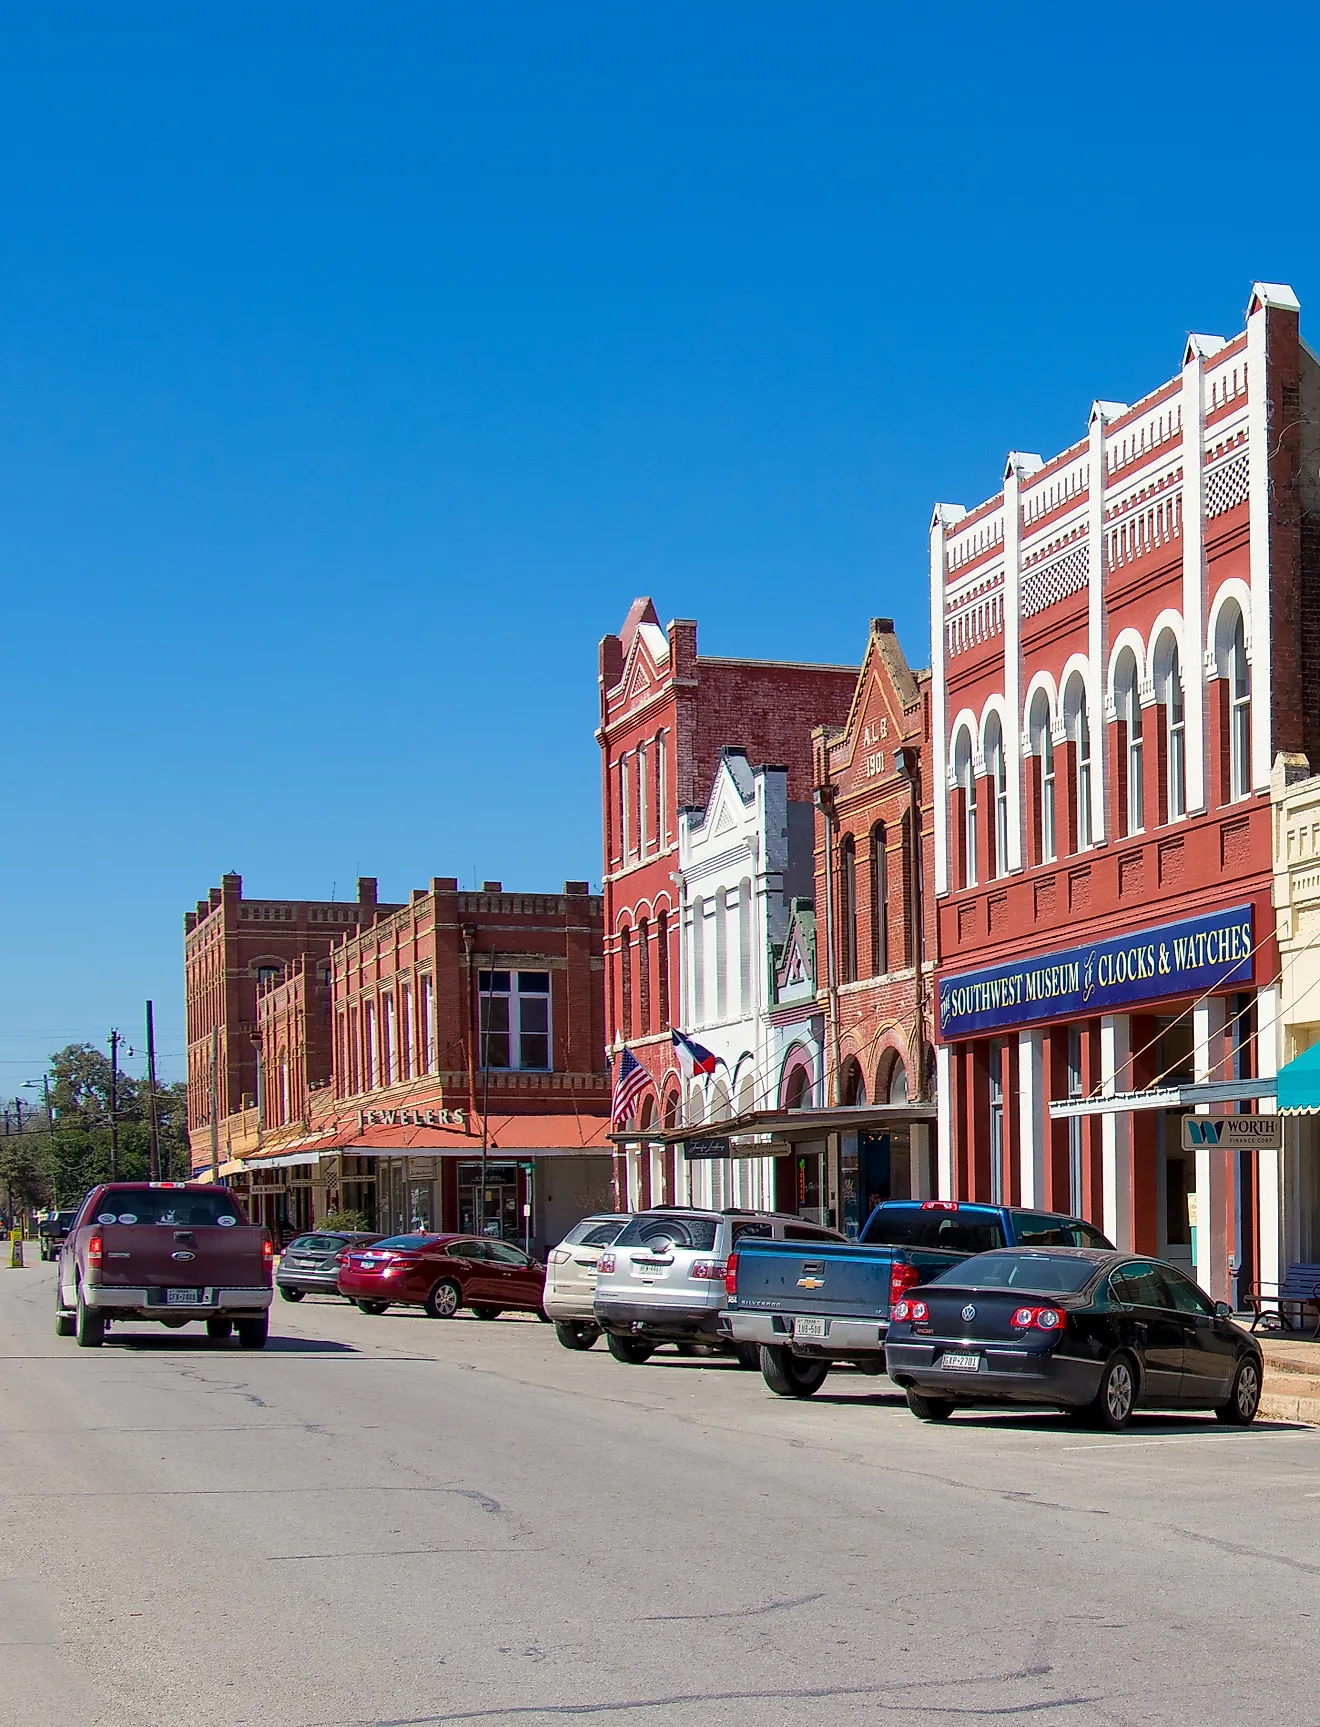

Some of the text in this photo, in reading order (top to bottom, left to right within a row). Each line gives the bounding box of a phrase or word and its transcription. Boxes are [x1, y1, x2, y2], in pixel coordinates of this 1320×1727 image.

[867, 751, 885, 778] 1901
[951, 973, 1023, 1017] SOUTHWEST
[1025, 961, 1079, 1002] MUSEUM
[1098, 944, 1154, 987] CLOCKS
[1158, 942, 1171, 975] &
[1173, 923, 1250, 972] WATCHES
[357, 1107, 465, 1128] JEWELERS
[1228, 1120, 1275, 1135] WORTH
